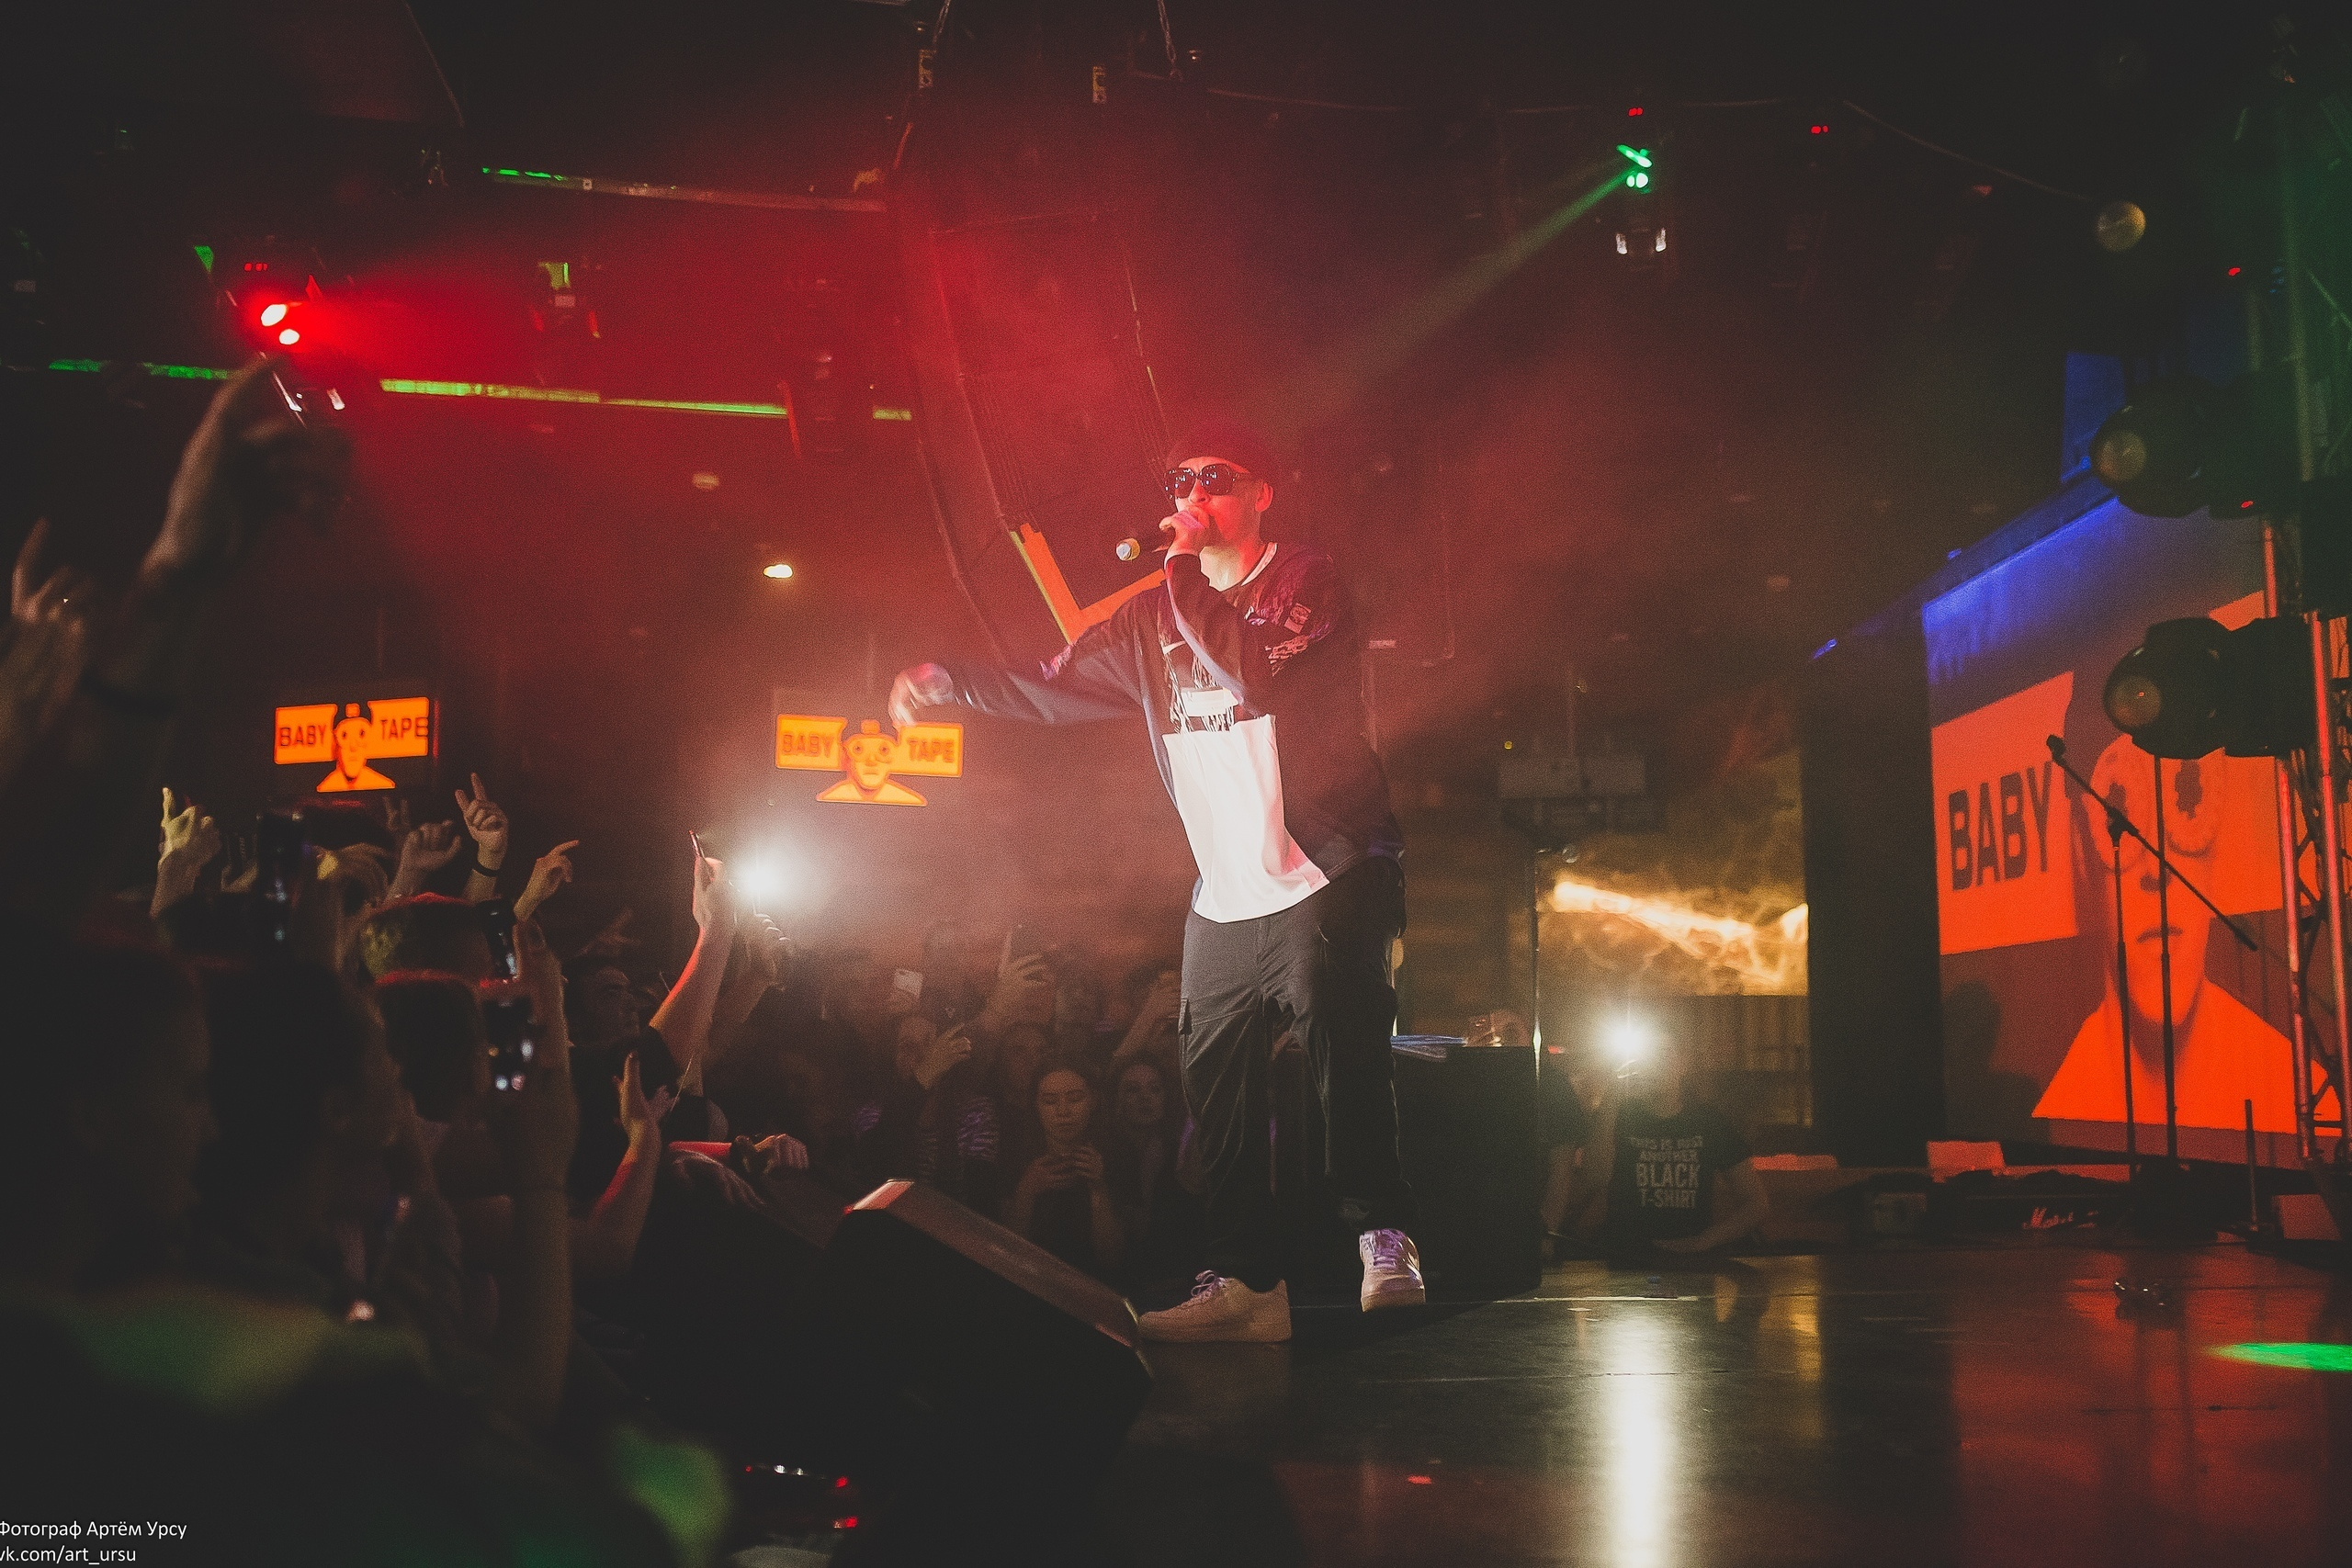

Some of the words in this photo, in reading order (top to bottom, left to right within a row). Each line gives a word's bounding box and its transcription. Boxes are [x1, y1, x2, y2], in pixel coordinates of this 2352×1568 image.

[279, 724, 327, 746] BABY
[380, 716, 429, 740] TAPE
[782, 733, 835, 758] BABY
[907, 738, 956, 763] TAPE
[1948, 761, 2052, 892] BABY
[1639, 1149, 1699, 1162] ANOTHER
[1635, 1162, 1701, 1188] BLACK
[1639, 1188, 1696, 1209] T-SHIRT
